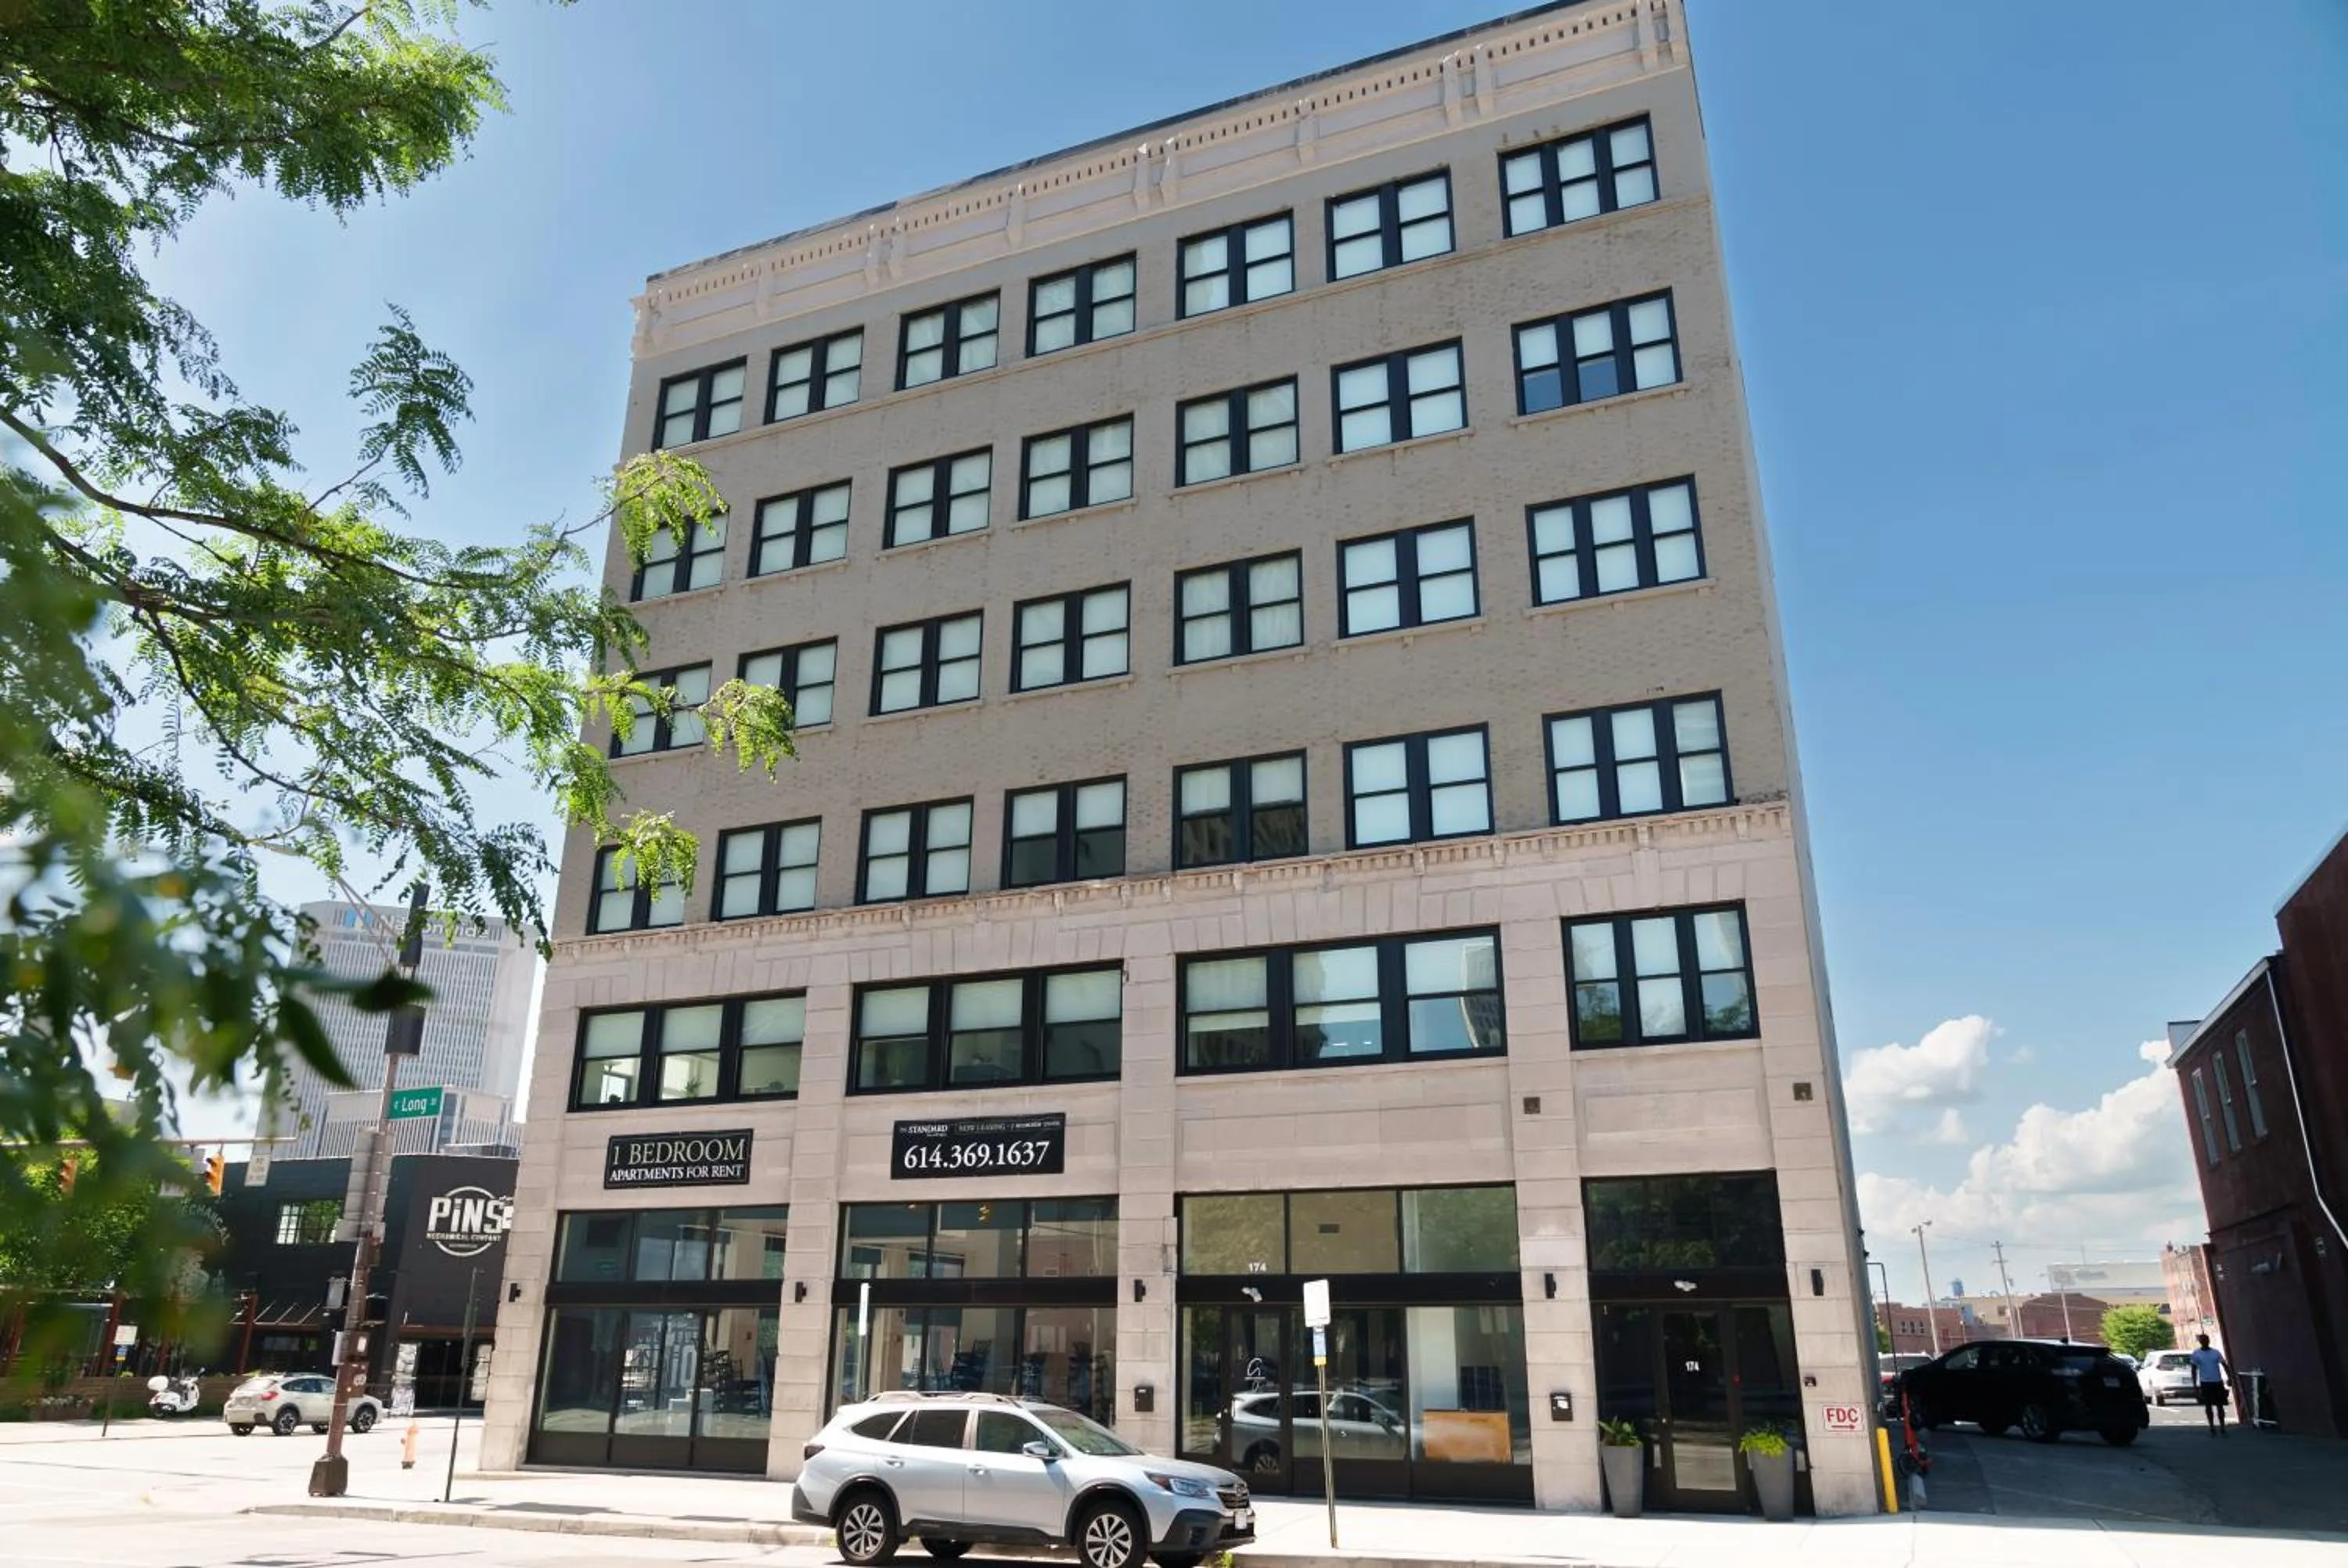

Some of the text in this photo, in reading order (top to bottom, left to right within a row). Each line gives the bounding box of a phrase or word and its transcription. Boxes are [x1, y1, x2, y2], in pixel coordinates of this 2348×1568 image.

[380, 914, 489, 938] Naonide
[402, 1096, 428, 1115] Long
[613, 1138, 745, 1165] 1 BEDROOM
[904, 1140, 1050, 1168] 614.369.1637
[610, 1163, 744, 1181] APARTMENTS FOR RENT
[1248, 1262, 1266, 1272] 174
[1685, 1361, 1699, 1372] 174
[1826, 1408, 1859, 1423] FDC
